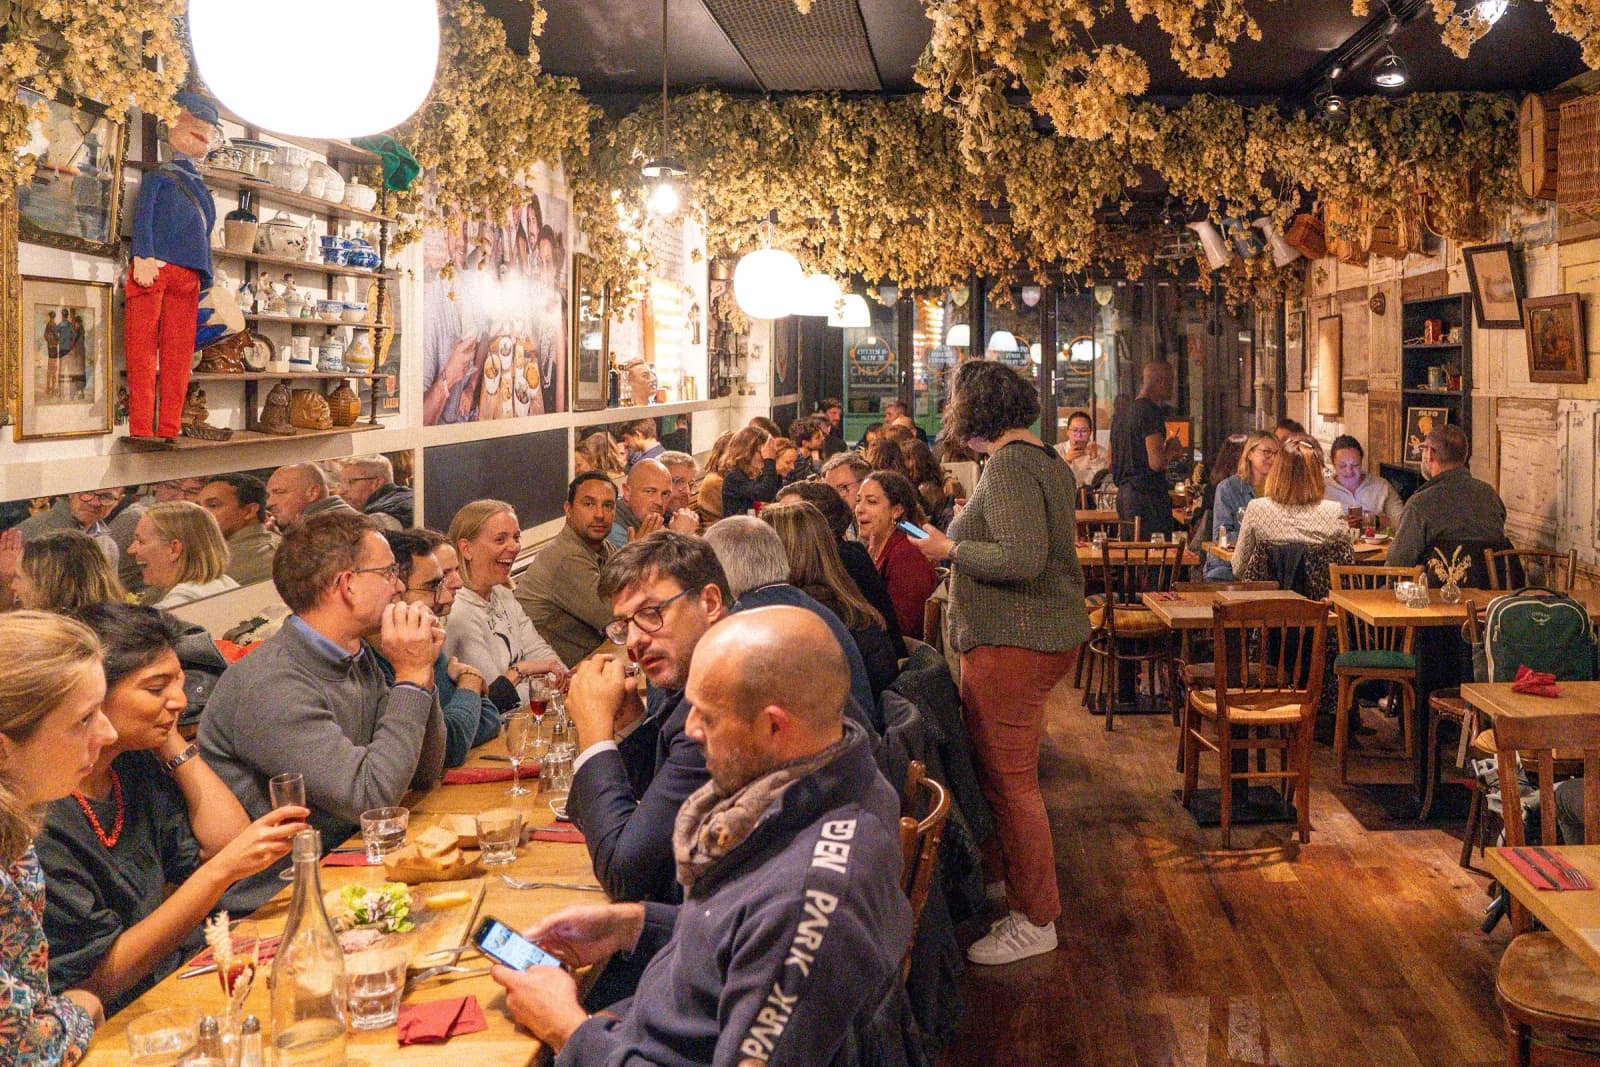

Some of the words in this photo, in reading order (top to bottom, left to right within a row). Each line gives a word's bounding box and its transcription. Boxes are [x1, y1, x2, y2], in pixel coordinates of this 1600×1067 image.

[812, 819, 857, 873] EDEN
[784, 889, 838, 977] PARK
[741, 982, 798, 1061] PARK
